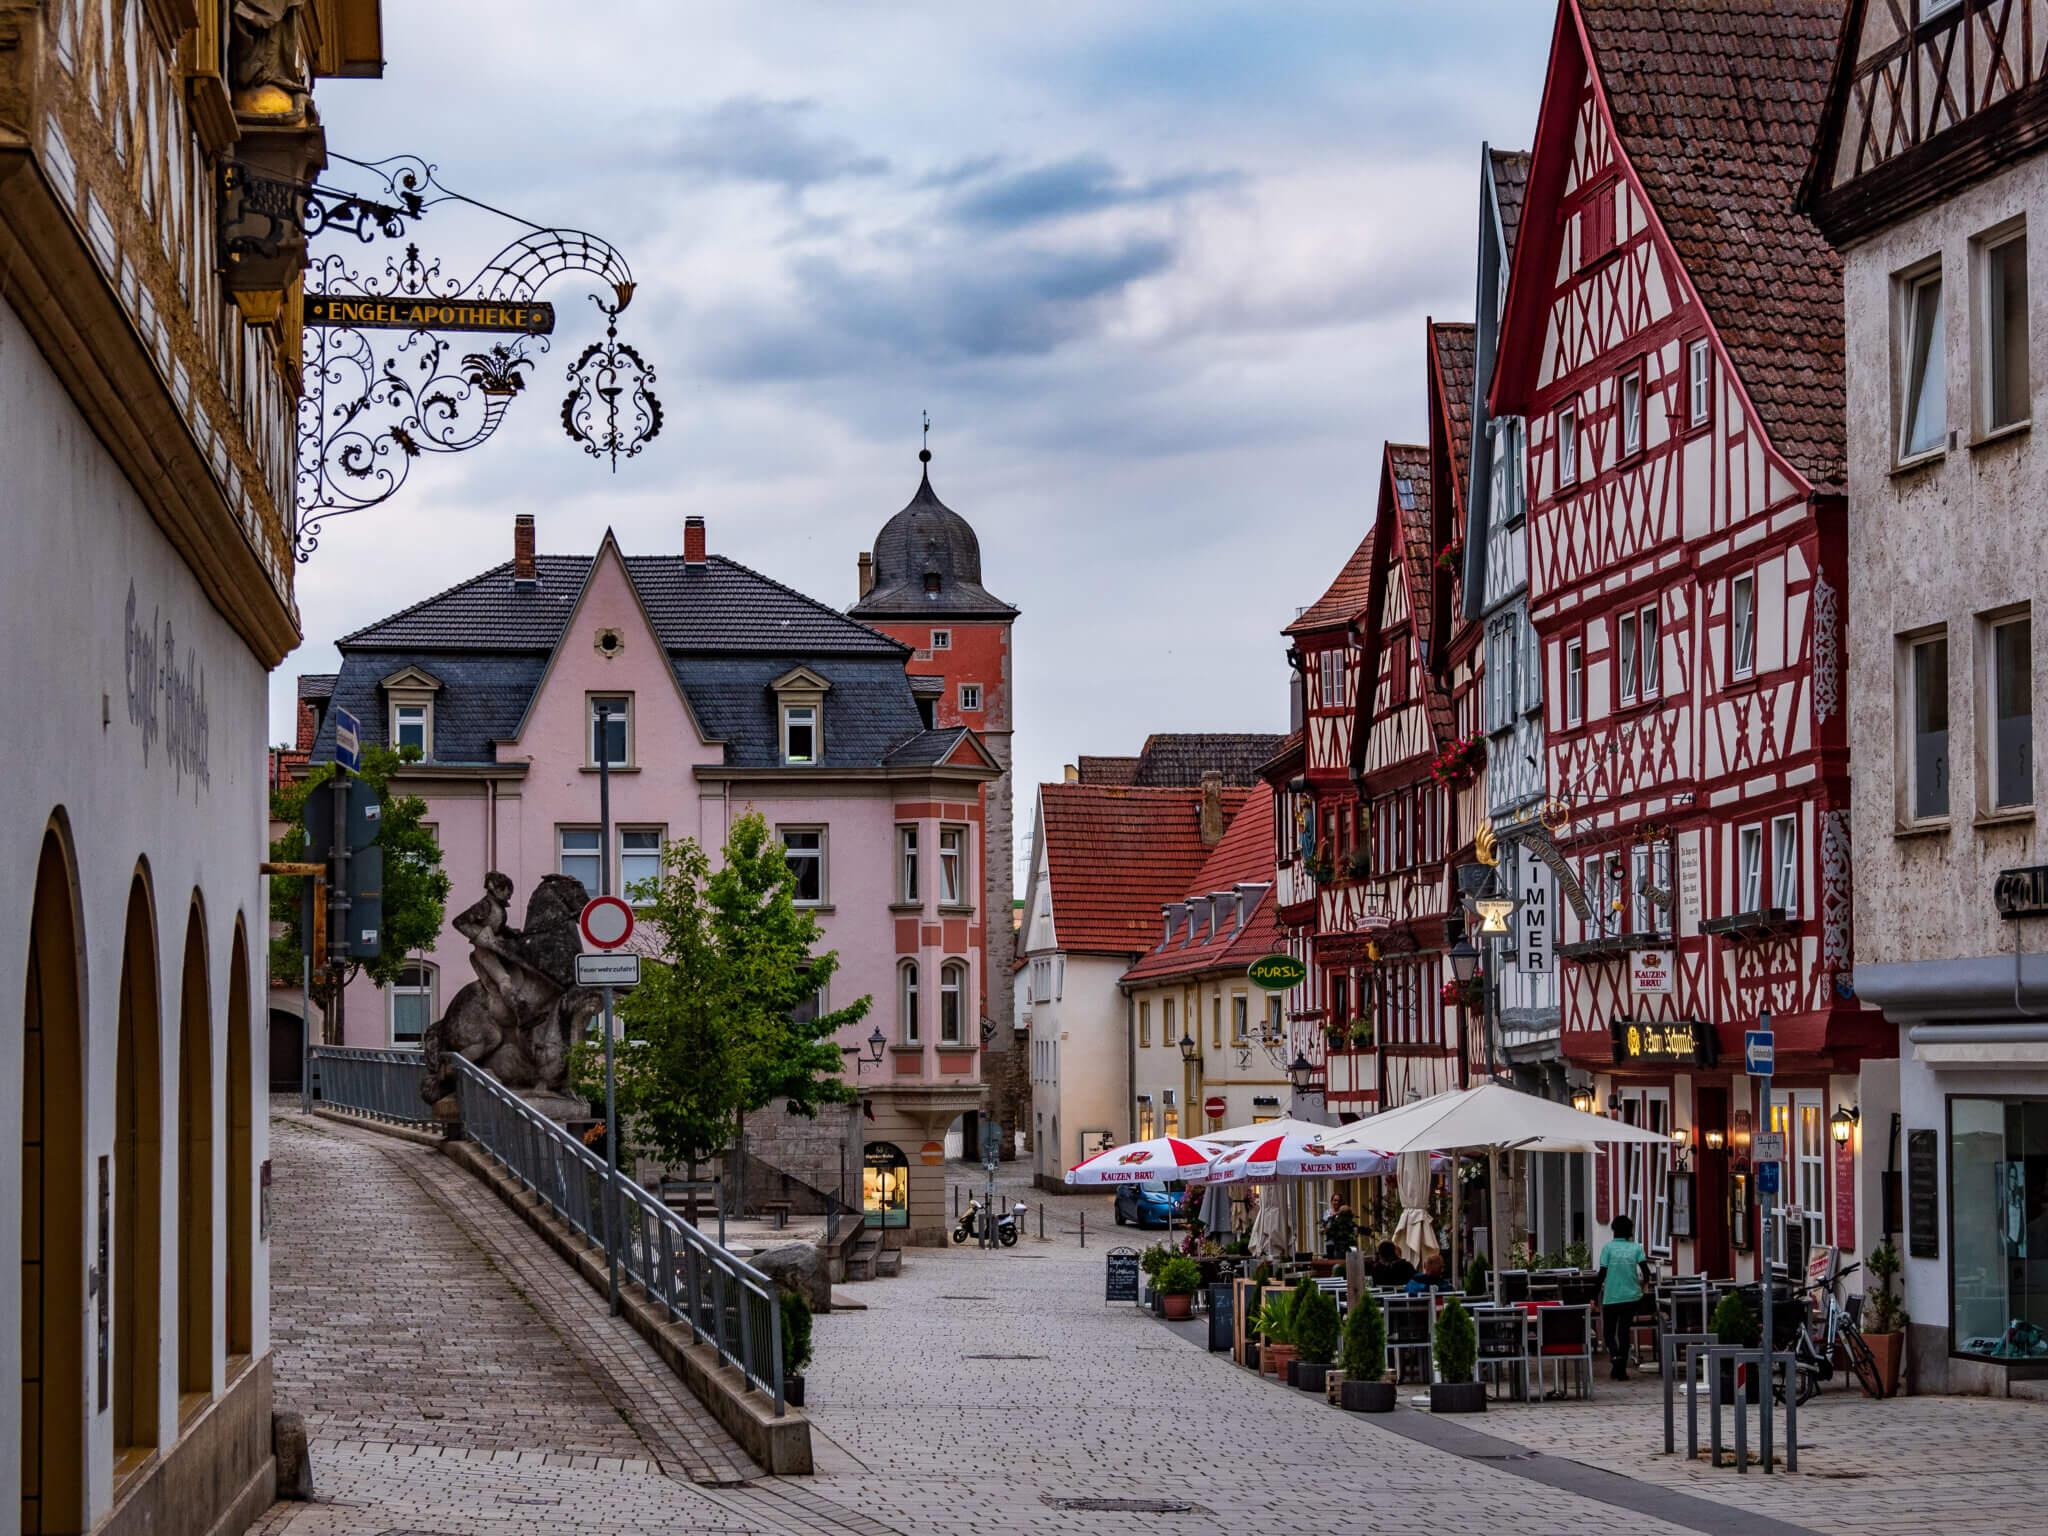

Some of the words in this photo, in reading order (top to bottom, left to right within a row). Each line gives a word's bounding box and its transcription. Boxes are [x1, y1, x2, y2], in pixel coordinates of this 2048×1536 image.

[328, 302, 528, 327] ENGEL-APOTHEKE
[1526, 852, 1545, 969] ZIMMER
[1634, 970, 1667, 979] KAUZEN
[1639, 978, 1662, 987] BRÄU
[1300, 1162, 1334, 1173] KAUZEN
[1335, 1161, 1358, 1172] BRÄU
[1101, 1171, 1132, 1182] KAUZEN
[1134, 1170, 1155, 1181] BRÄU
